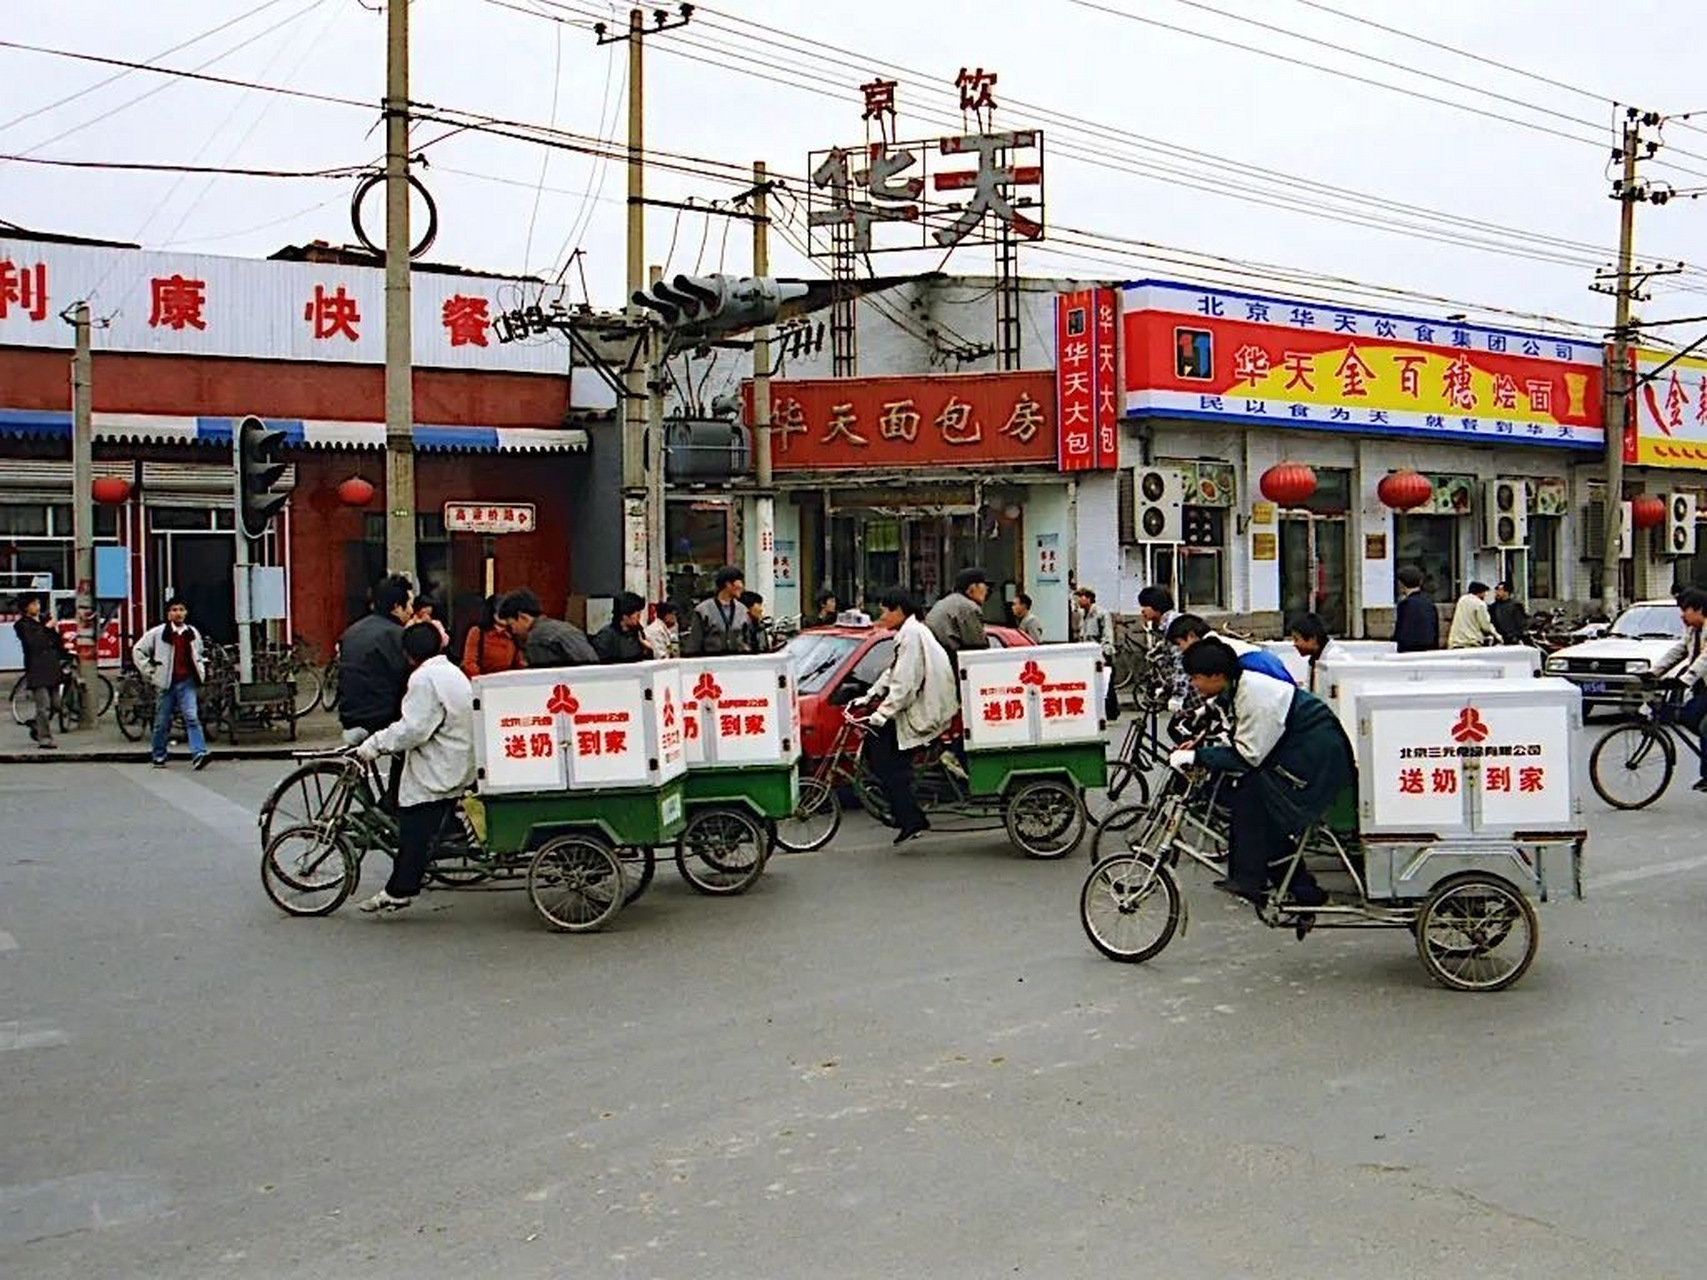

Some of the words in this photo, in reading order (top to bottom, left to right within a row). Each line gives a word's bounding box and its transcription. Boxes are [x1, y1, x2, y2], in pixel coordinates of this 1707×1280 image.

[808, 131, 1042, 252] 华天
[0, 260, 489, 347] 利康快餐
[1198, 296, 1573, 361] 北京华天饮食集团公司
[1064, 341, 1090, 455] 华天大包
[1100, 305, 1115, 454] 华天大包
[1200, 395, 1389, 425] 民以食为天
[1234, 342, 1553, 415] 华天金百穗烩面
[770, 392, 1047, 453] 华天面包房
[983, 696, 1085, 721] 送奶到家
[504, 730, 627, 758] 送奶到家
[1398, 765, 1544, 794] 送奶到家
